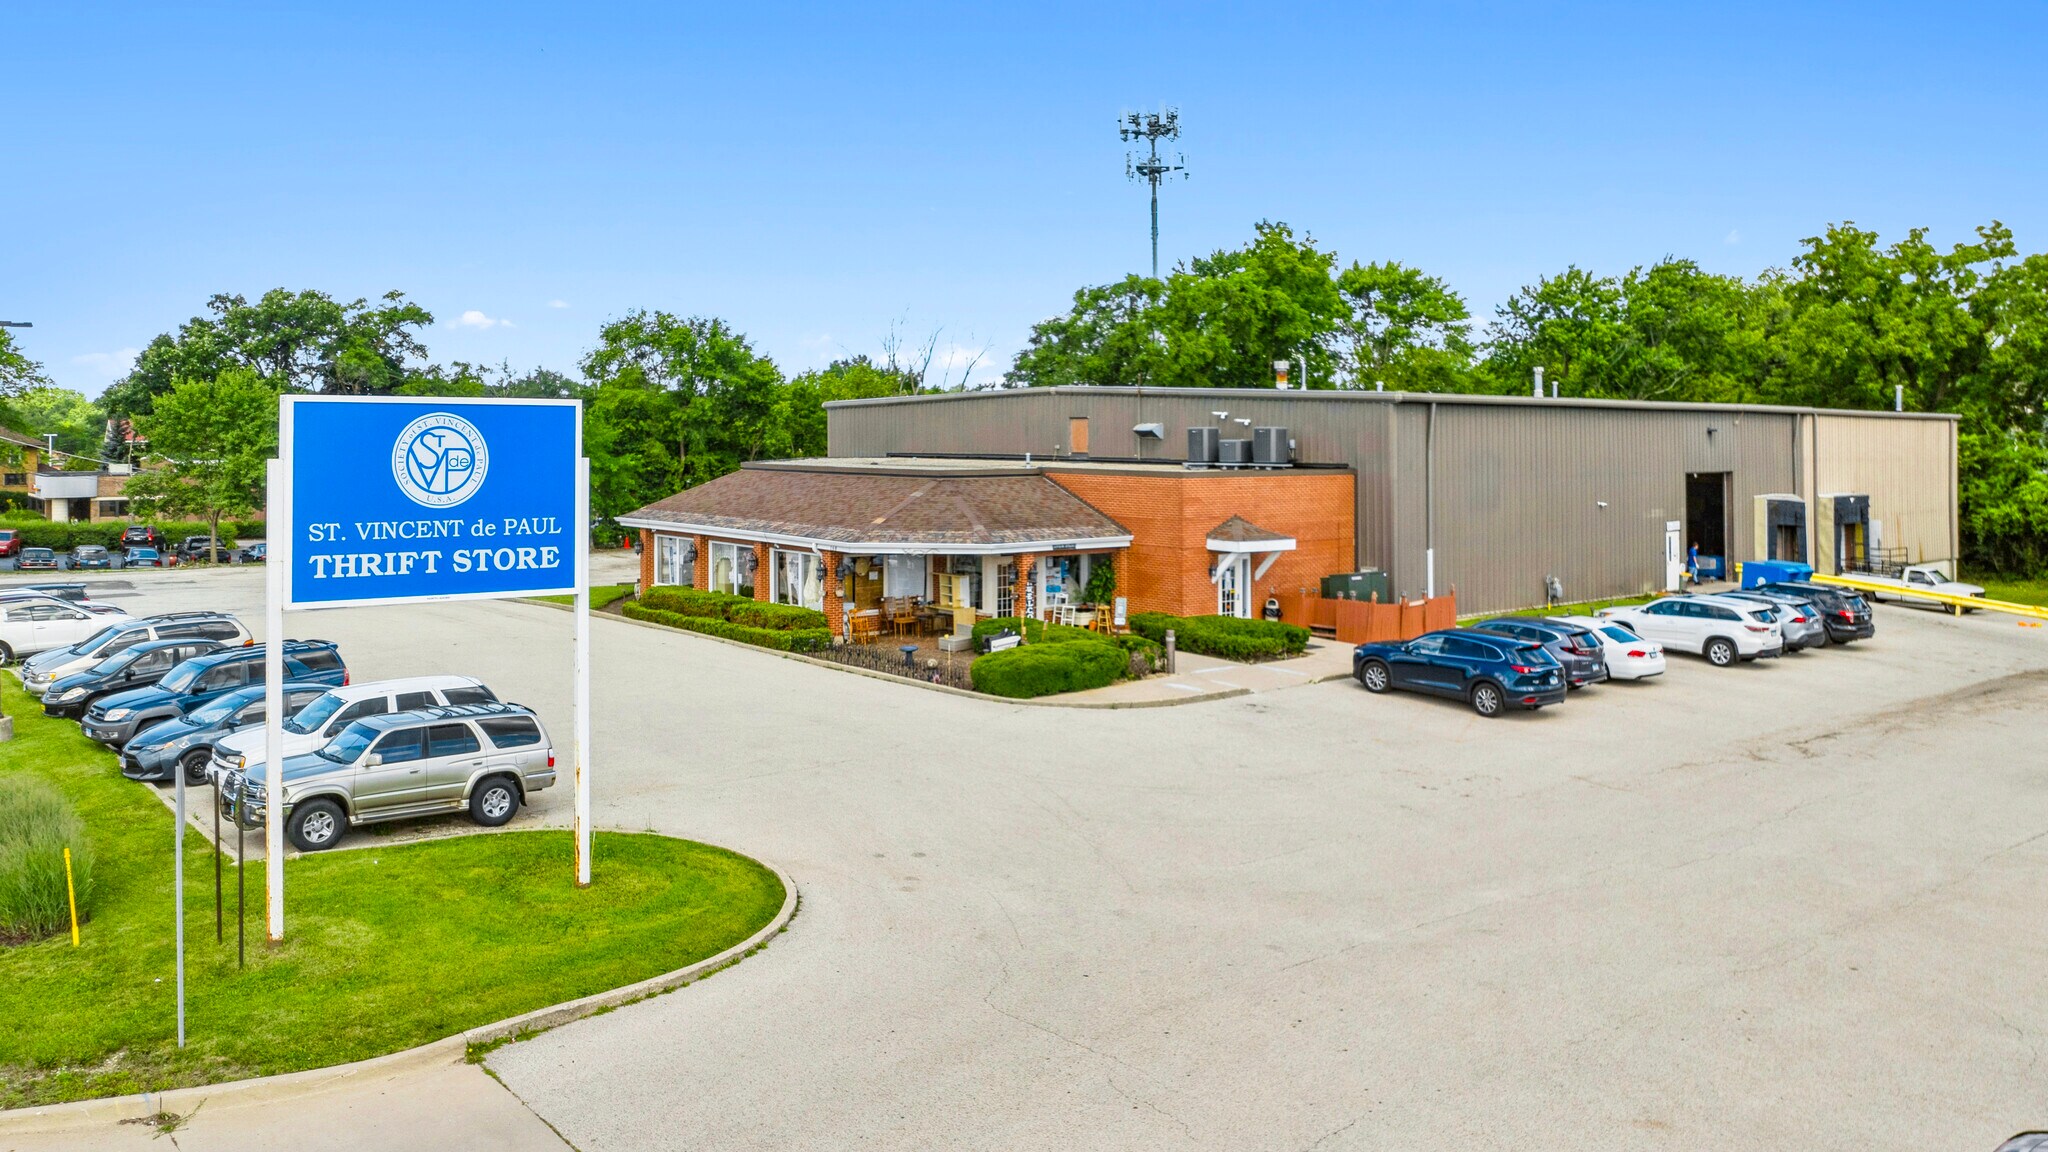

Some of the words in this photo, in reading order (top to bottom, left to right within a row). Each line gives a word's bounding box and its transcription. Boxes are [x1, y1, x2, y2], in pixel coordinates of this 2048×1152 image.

[398, 440, 410, 486] SOCIETY
[435, 417, 478, 443] VINCENT
[471, 458, 484, 484] PAUL
[426, 494, 456, 503] U.S.A.
[308, 522, 346, 542] ST.
[355, 519, 464, 540] VINCENT
[470, 518, 496, 537] de
[503, 517, 562, 536] PAUL
[308, 550, 442, 579] THRIFT
[452, 546, 560, 573] STORE
